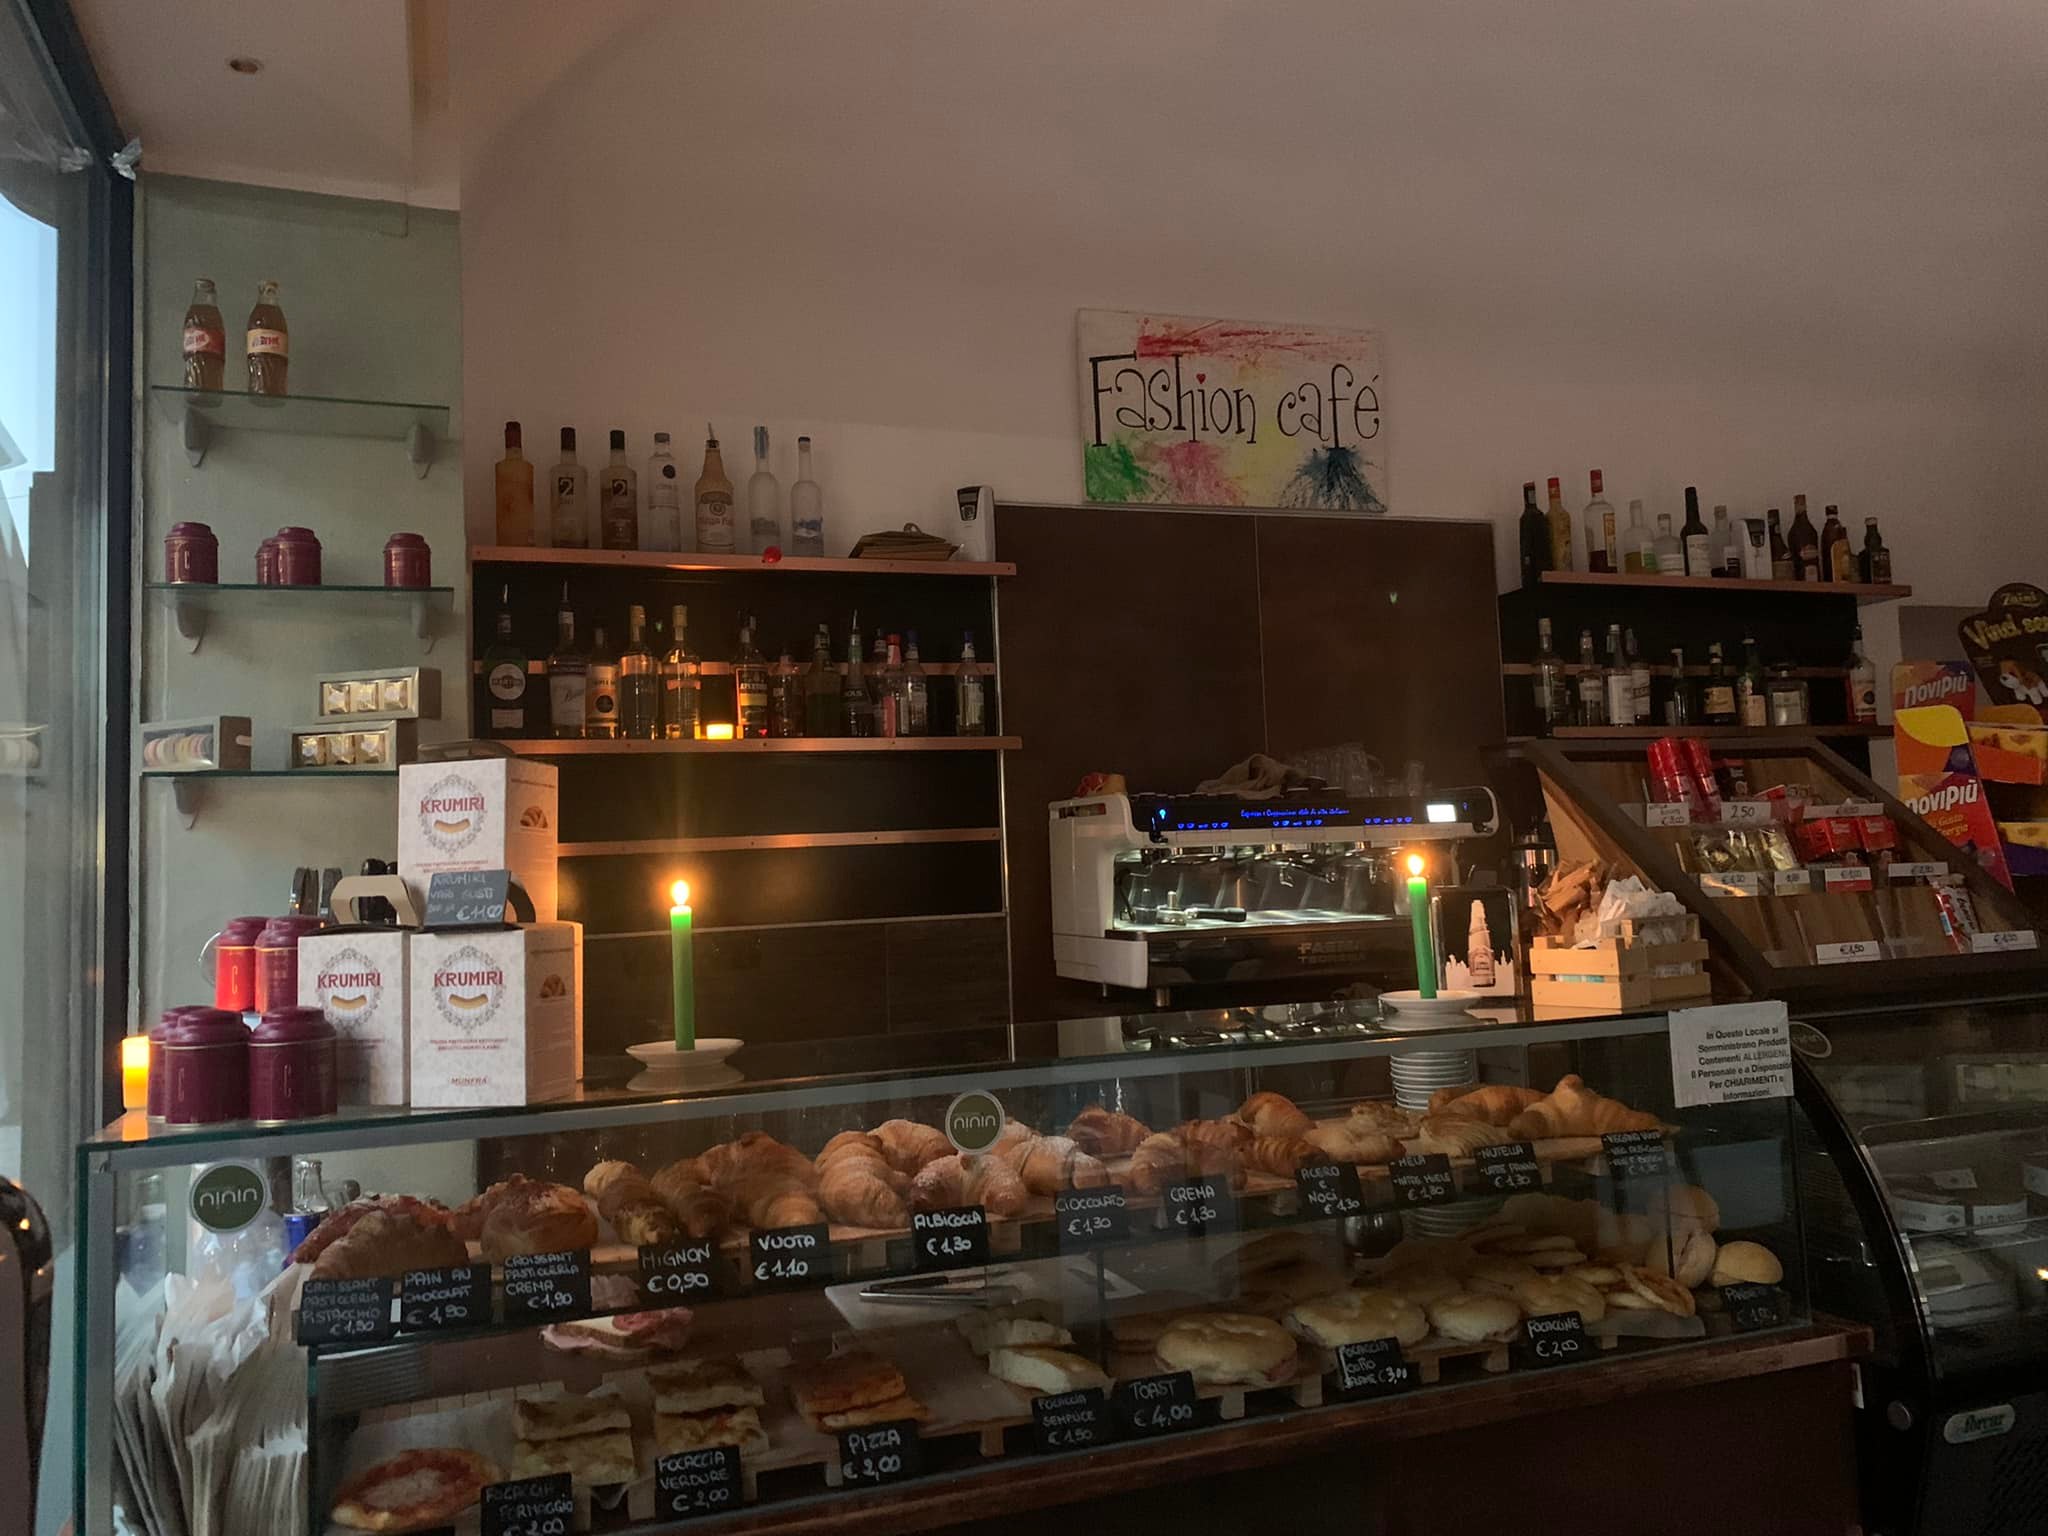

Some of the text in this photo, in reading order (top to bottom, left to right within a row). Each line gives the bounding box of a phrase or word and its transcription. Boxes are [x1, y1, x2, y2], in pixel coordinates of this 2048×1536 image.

[1088, 350, 1380, 449] Fashion café
[421, 796, 485, 814] KRUMIRI
[317, 973, 381, 989] KRUMIRI
[434, 971, 503, 987] KRUMIRI
[1706, 1026, 1779, 1040] In Questo Locale si
[1698, 1068, 1737, 1078] Personale
[1709, 1080, 1722, 1089] Per
[1170, 1184, 1216, 1202] CREMA
[1055, 1193, 1126, 1212] CIOCCOLATO
[758, 1234, 816, 1251] VUOTA
[505, 1251, 574, 1267] CROISSANT
[405, 1268, 472, 1288] PAIN AU
[505, 1279, 554, 1296] CREMA
[1128, 1379, 1177, 1400] TOAST
[848, 1429, 901, 1455] PIZZA
[658, 1451, 725, 1473] FOCACCIA
[659, 1468, 728, 1490] VERDURE
